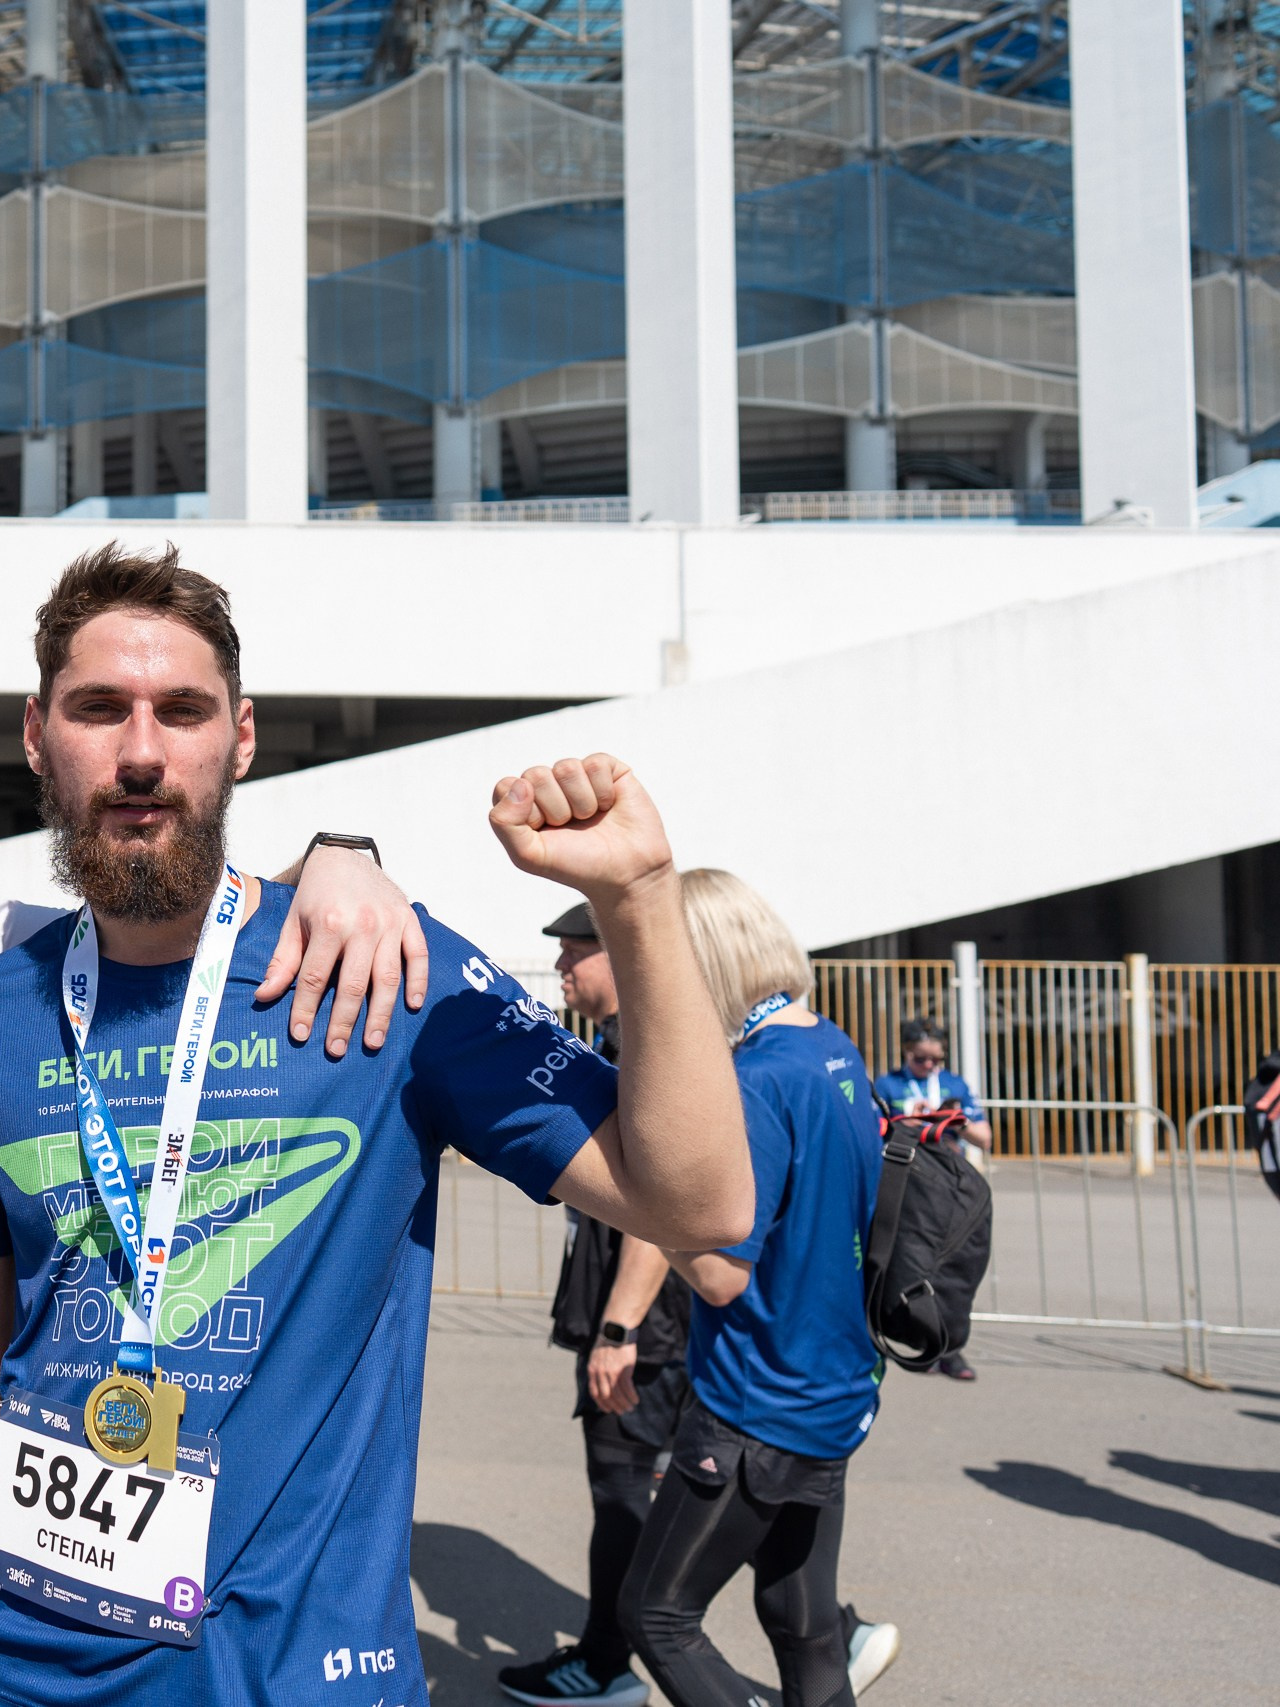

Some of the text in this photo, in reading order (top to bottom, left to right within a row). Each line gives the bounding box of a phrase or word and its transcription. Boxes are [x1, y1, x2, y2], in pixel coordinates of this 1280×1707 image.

[216, 886, 239, 925] ПСБ
[71, 974, 88, 1011] ПСБ
[138, 1032, 278, 1077] ГЕОЙ!
[180, 996, 209, 1083] БЕГИ, ГЕРОЙ!
[38, 1087, 279, 1116] 10 БЛАГРИТЕЛЬН ЛУМАРАФОН
[38, 1118, 280, 1188] ГРОИ
[86, 1114, 126, 1189] ЭТОТ
[44, 1360, 101, 1380] НИЖНИЙ
[9, 1400, 30, 1416] 10 КМ
[12, 1441, 165, 1543] 5847
[37, 1528, 115, 1571] СТЕПАН
[163, 1619, 187, 1632] ПСБ
[358, 1648, 396, 1674] ПСБ
